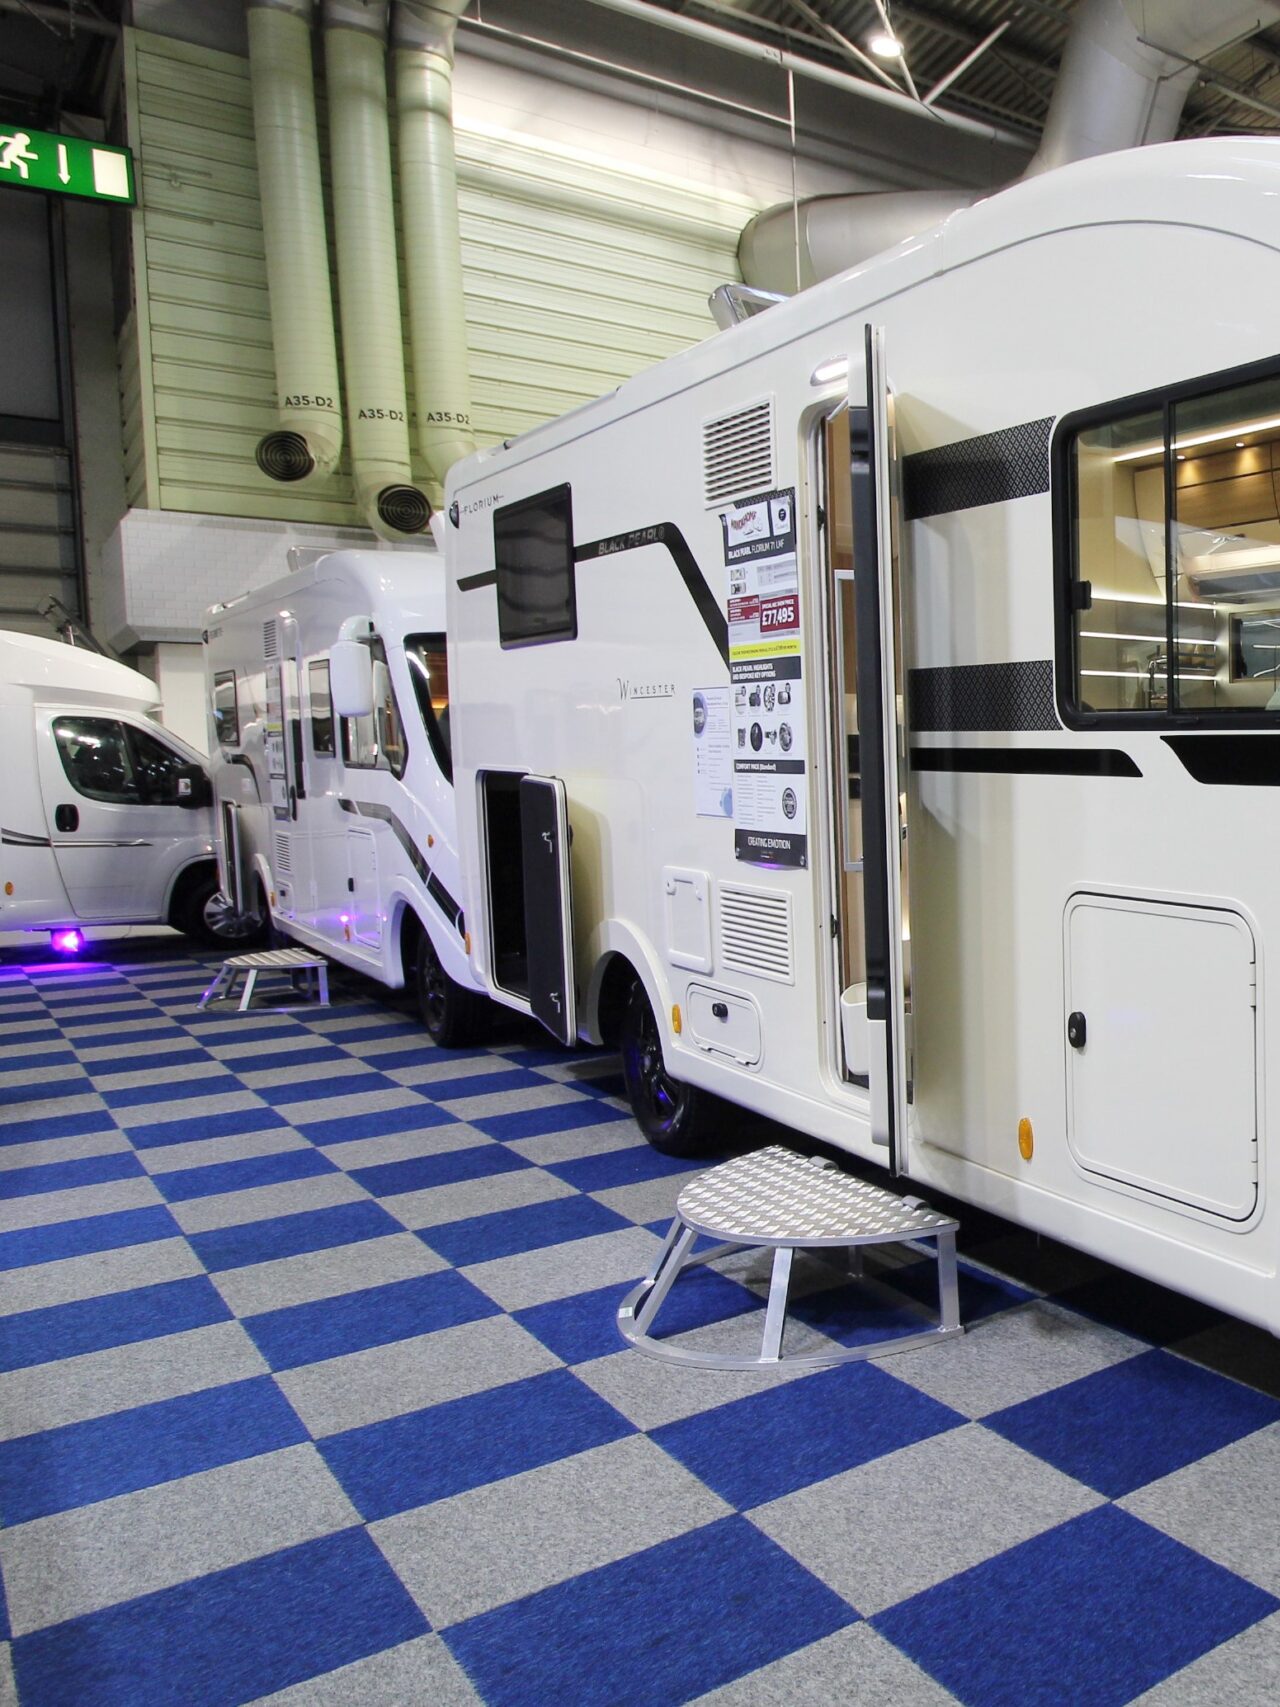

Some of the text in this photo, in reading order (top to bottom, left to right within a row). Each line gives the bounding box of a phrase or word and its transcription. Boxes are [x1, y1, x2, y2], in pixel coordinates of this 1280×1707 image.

[285, 395, 334, 408] A35-D2
[358, 408, 405, 422] A35-D2
[426, 412, 471, 425] A35-D2
[463, 494, 500, 515] FLORIUM
[598, 537, 625, 556] BLACK
[762, 607, 795, 626] £77,495
[767, 838, 791, 850] EMOTION
